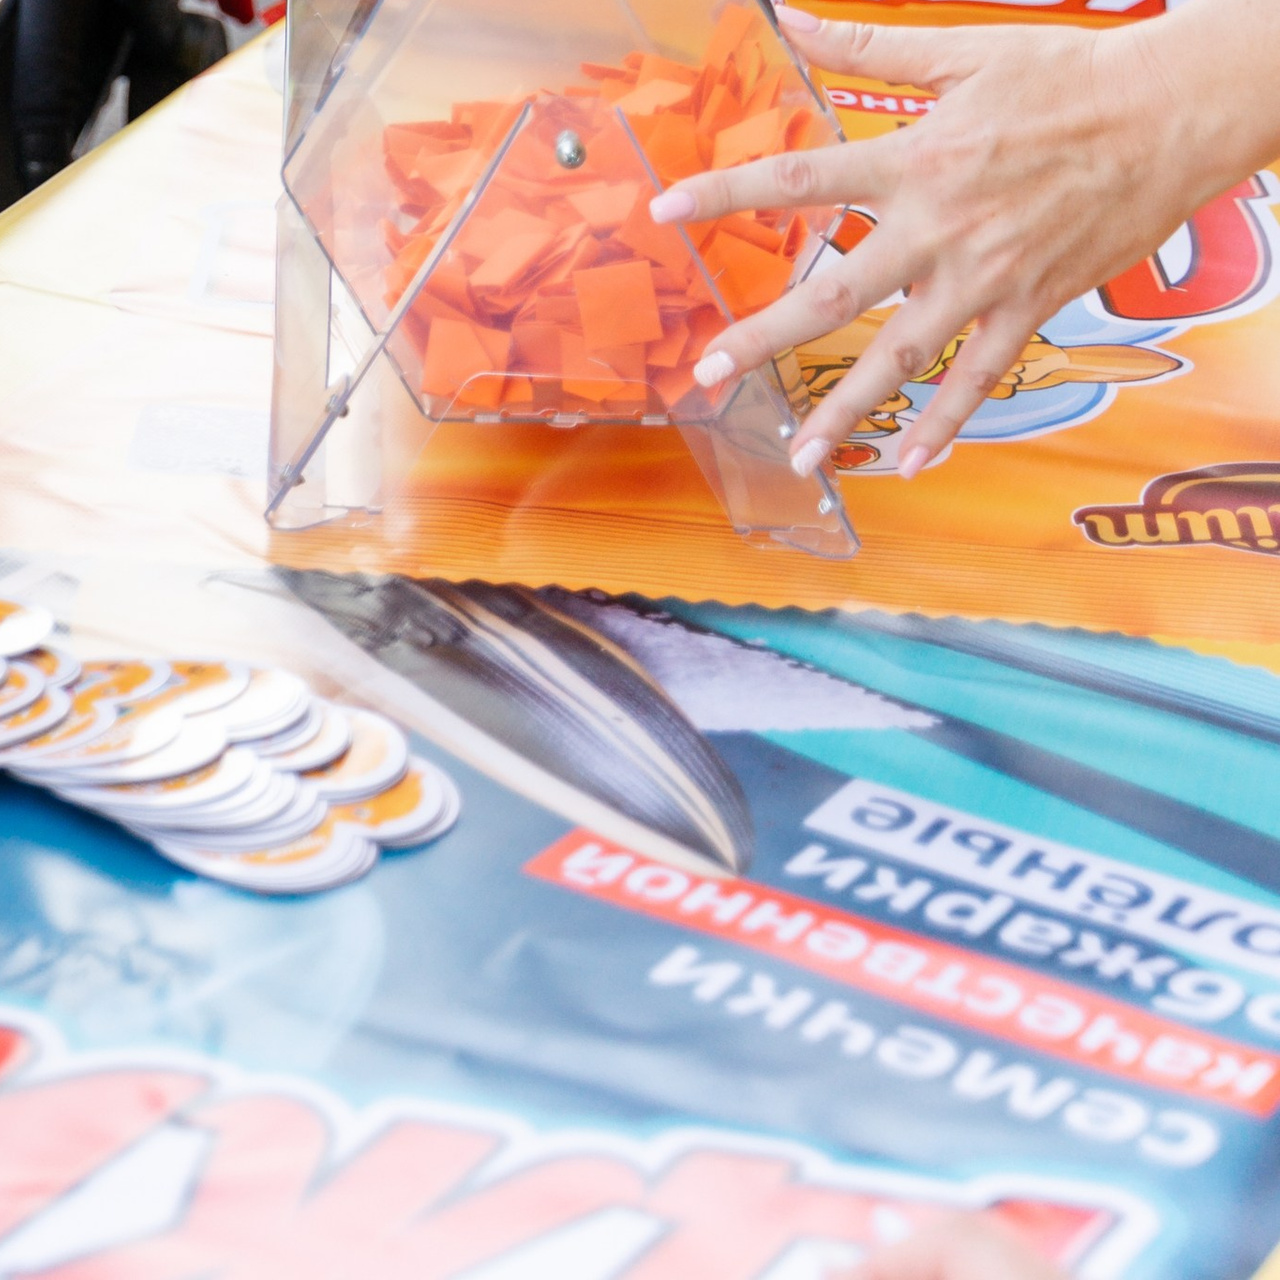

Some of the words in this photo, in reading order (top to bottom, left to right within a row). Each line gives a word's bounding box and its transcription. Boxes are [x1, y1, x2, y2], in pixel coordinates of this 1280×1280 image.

[1084, 505, 1280, 549] ium
[562, 841, 1276, 1099] качественной
[850, 794, 1280, 957] олёные
[648, 945, 1221, 1169] семечки
